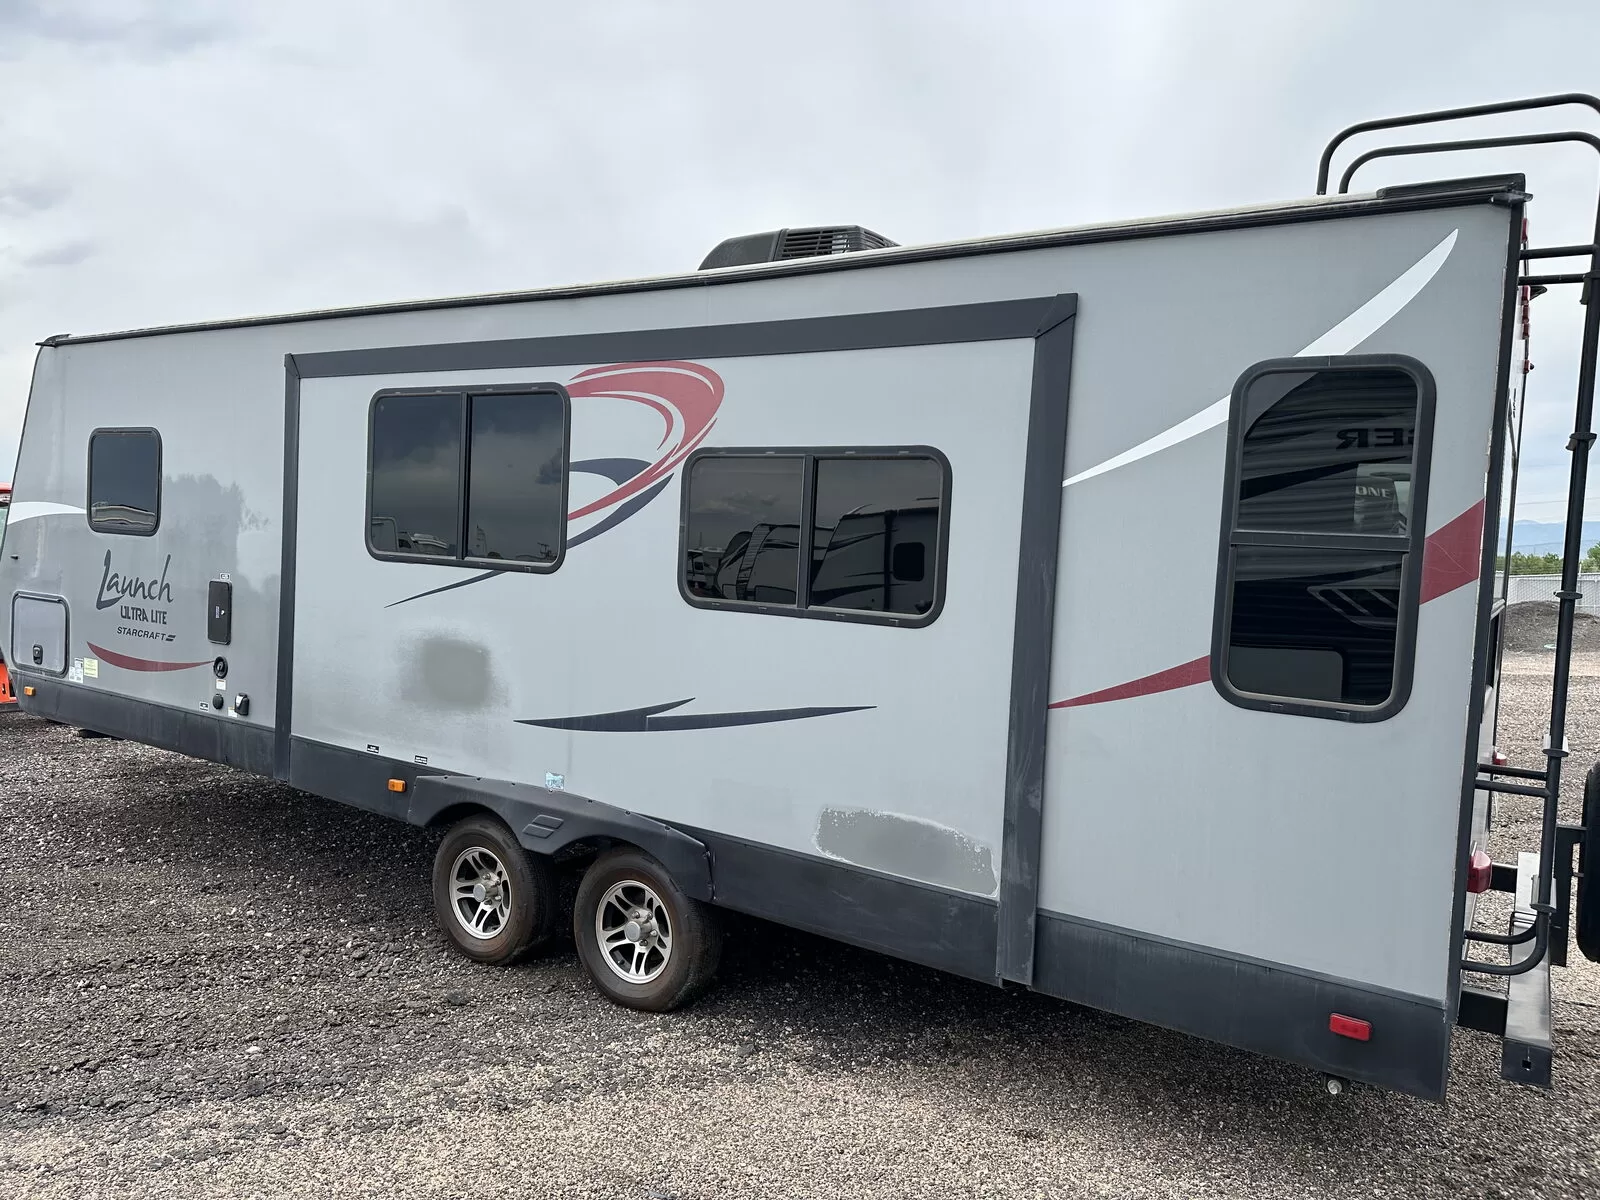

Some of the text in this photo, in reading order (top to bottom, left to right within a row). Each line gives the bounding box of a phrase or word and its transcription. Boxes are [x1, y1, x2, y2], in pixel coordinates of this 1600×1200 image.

[96, 549, 174, 610] Launch
[120, 605, 168, 625] ULTRA LITE
[117, 626, 166, 641] STARCRAFT
